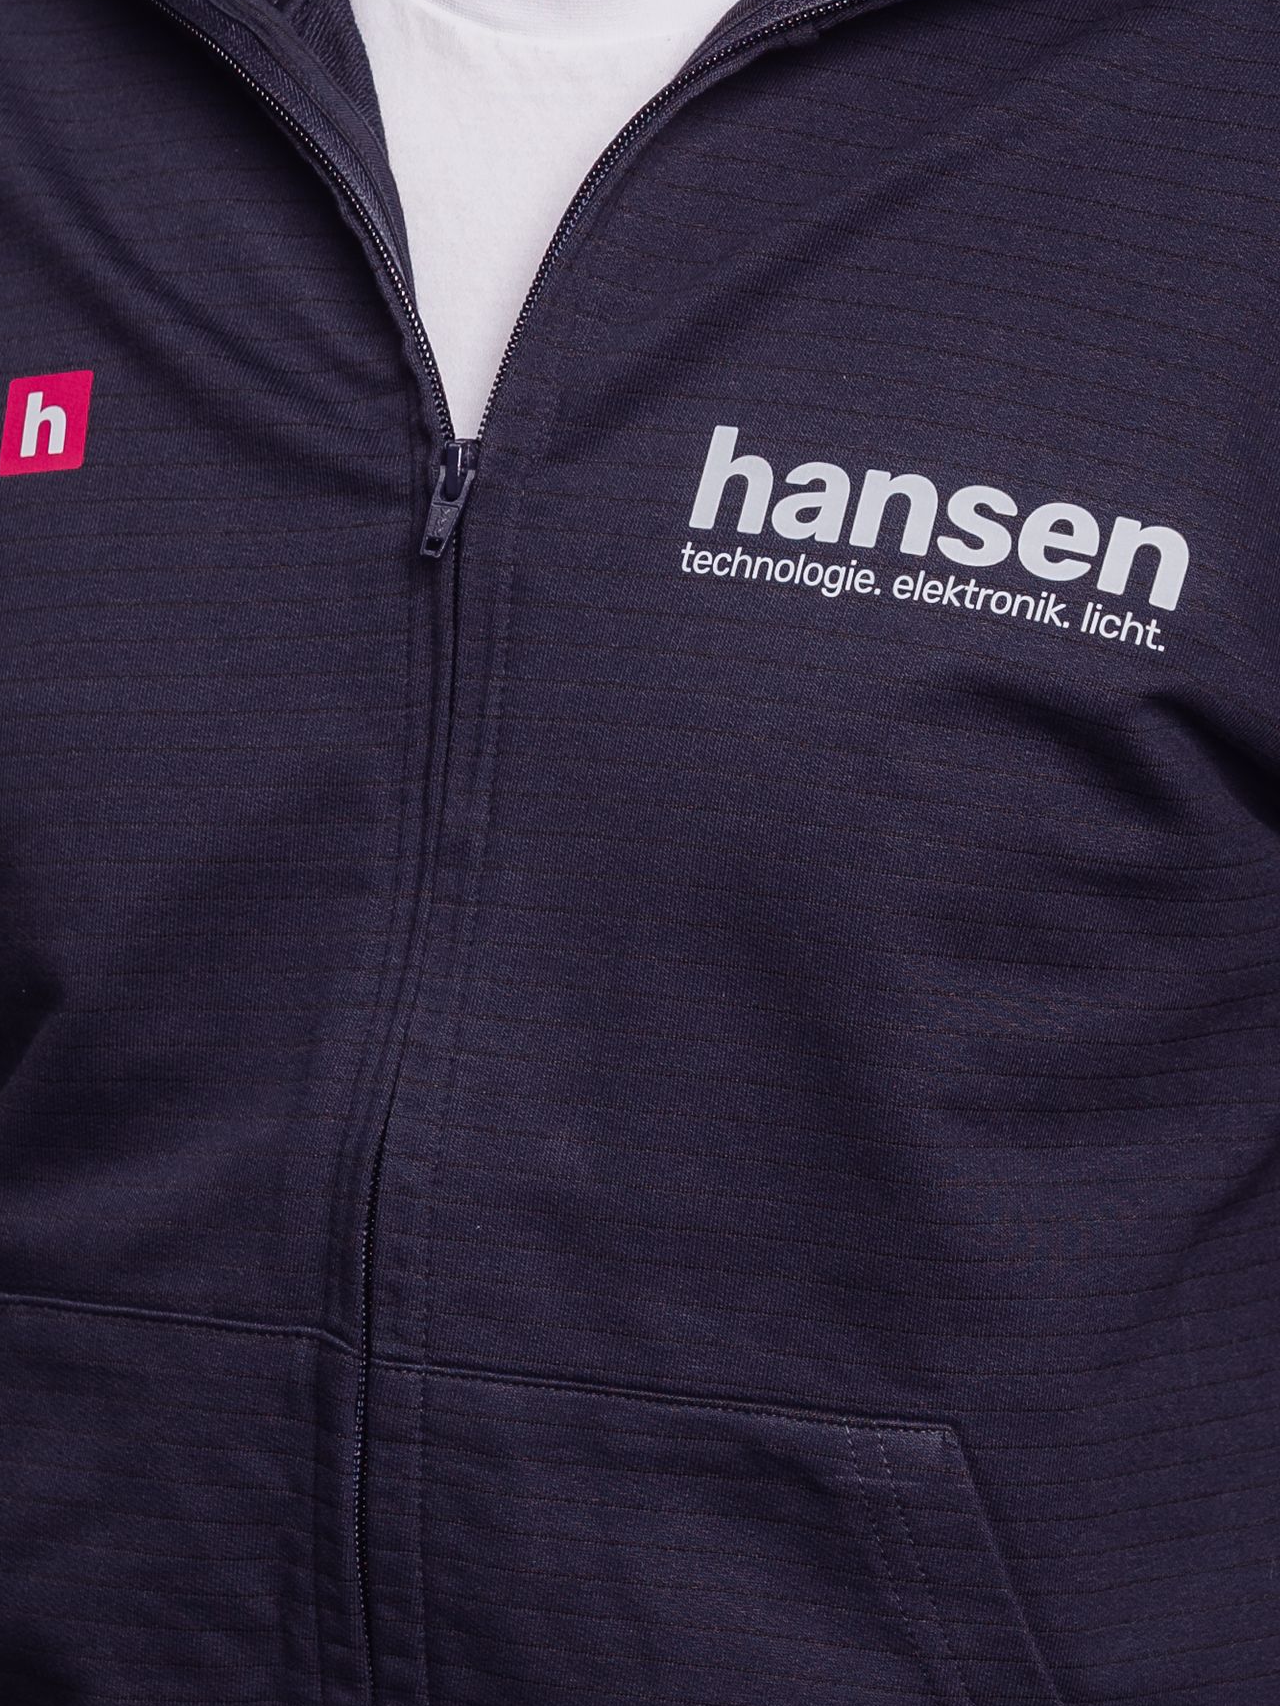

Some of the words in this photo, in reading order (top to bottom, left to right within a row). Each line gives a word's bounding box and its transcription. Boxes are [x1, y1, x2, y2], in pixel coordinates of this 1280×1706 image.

[20, 391, 67, 458] h
[688, 424, 1190, 612] hansen
[681, 541, 881, 598] technologie.
[892, 569, 1070, 629] elektronik.
[1080, 601, 1165, 652] licht.
